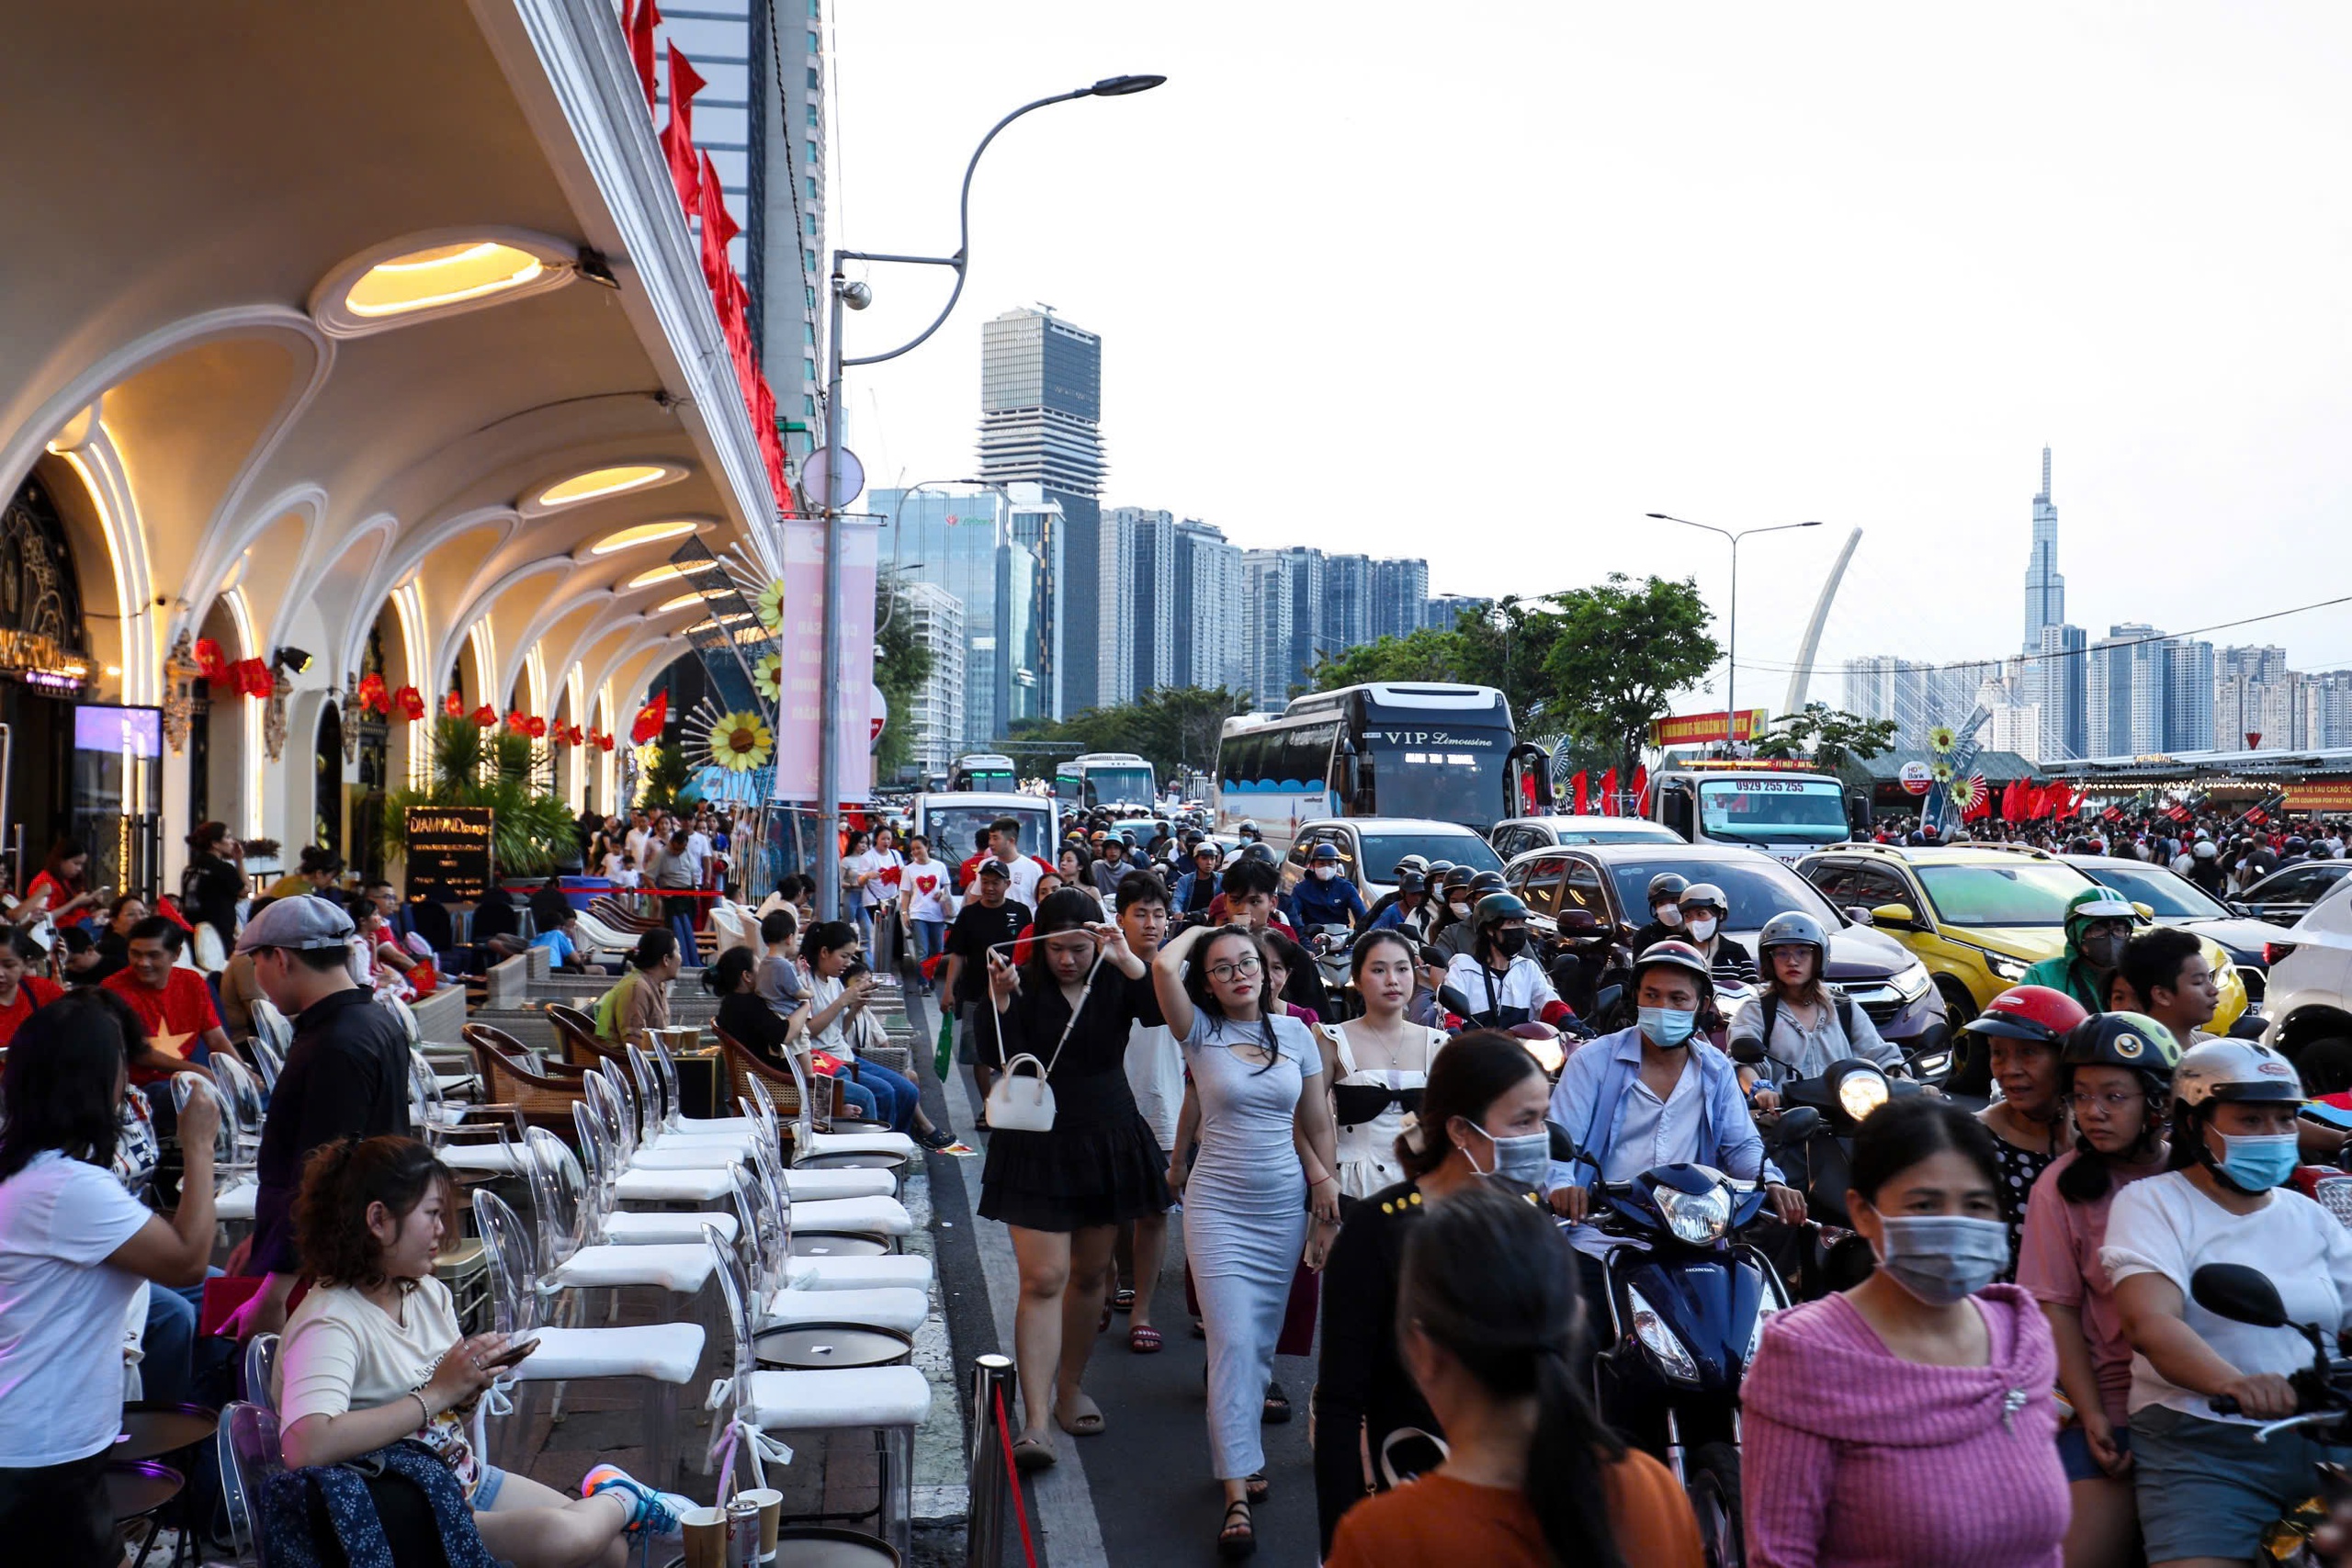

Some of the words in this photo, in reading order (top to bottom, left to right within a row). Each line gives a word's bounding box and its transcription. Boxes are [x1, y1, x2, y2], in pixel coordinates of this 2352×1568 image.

[1385, 732, 1428, 745] VIP
[1431, 732, 1493, 747] Limousine
[1736, 781, 1761, 791] 0929
[1765, 781, 1782, 791] 255
[1785, 782, 1804, 793] 255
